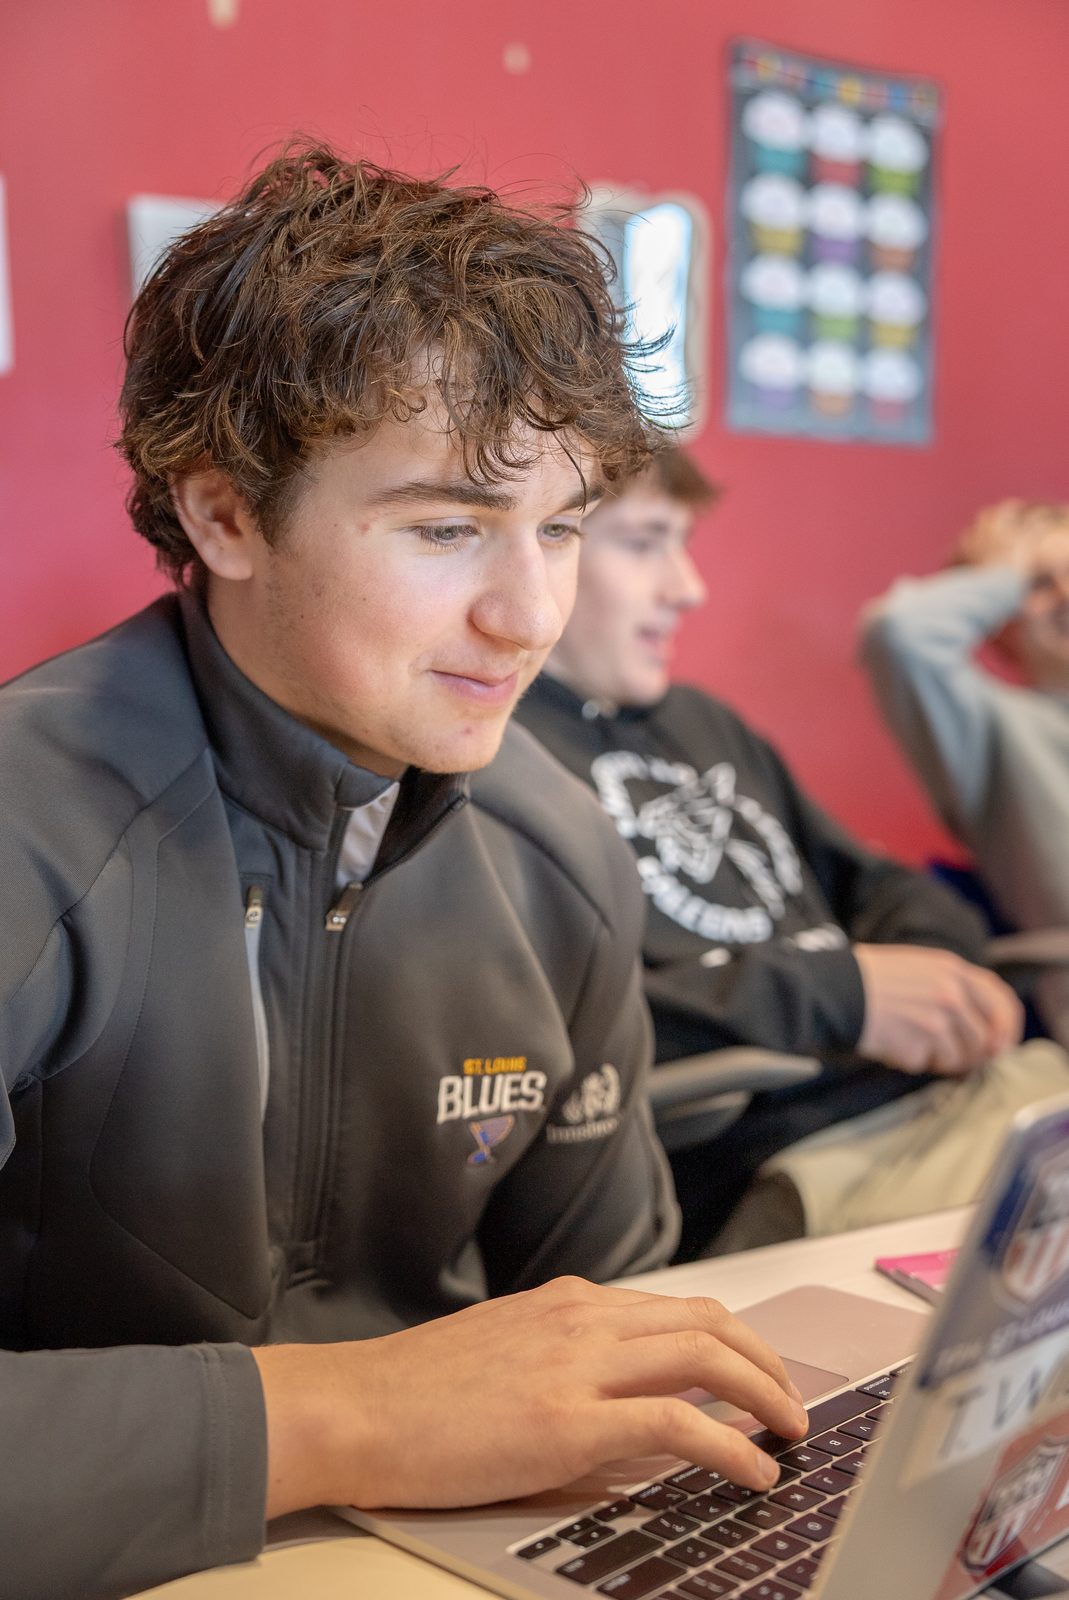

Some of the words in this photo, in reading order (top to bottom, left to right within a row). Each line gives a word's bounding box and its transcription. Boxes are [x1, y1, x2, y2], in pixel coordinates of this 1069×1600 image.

[485, 1056, 527, 1074] LOUIS
[437, 1070, 547, 1124] BLUES
[756, 1510, 772, 1518] L
